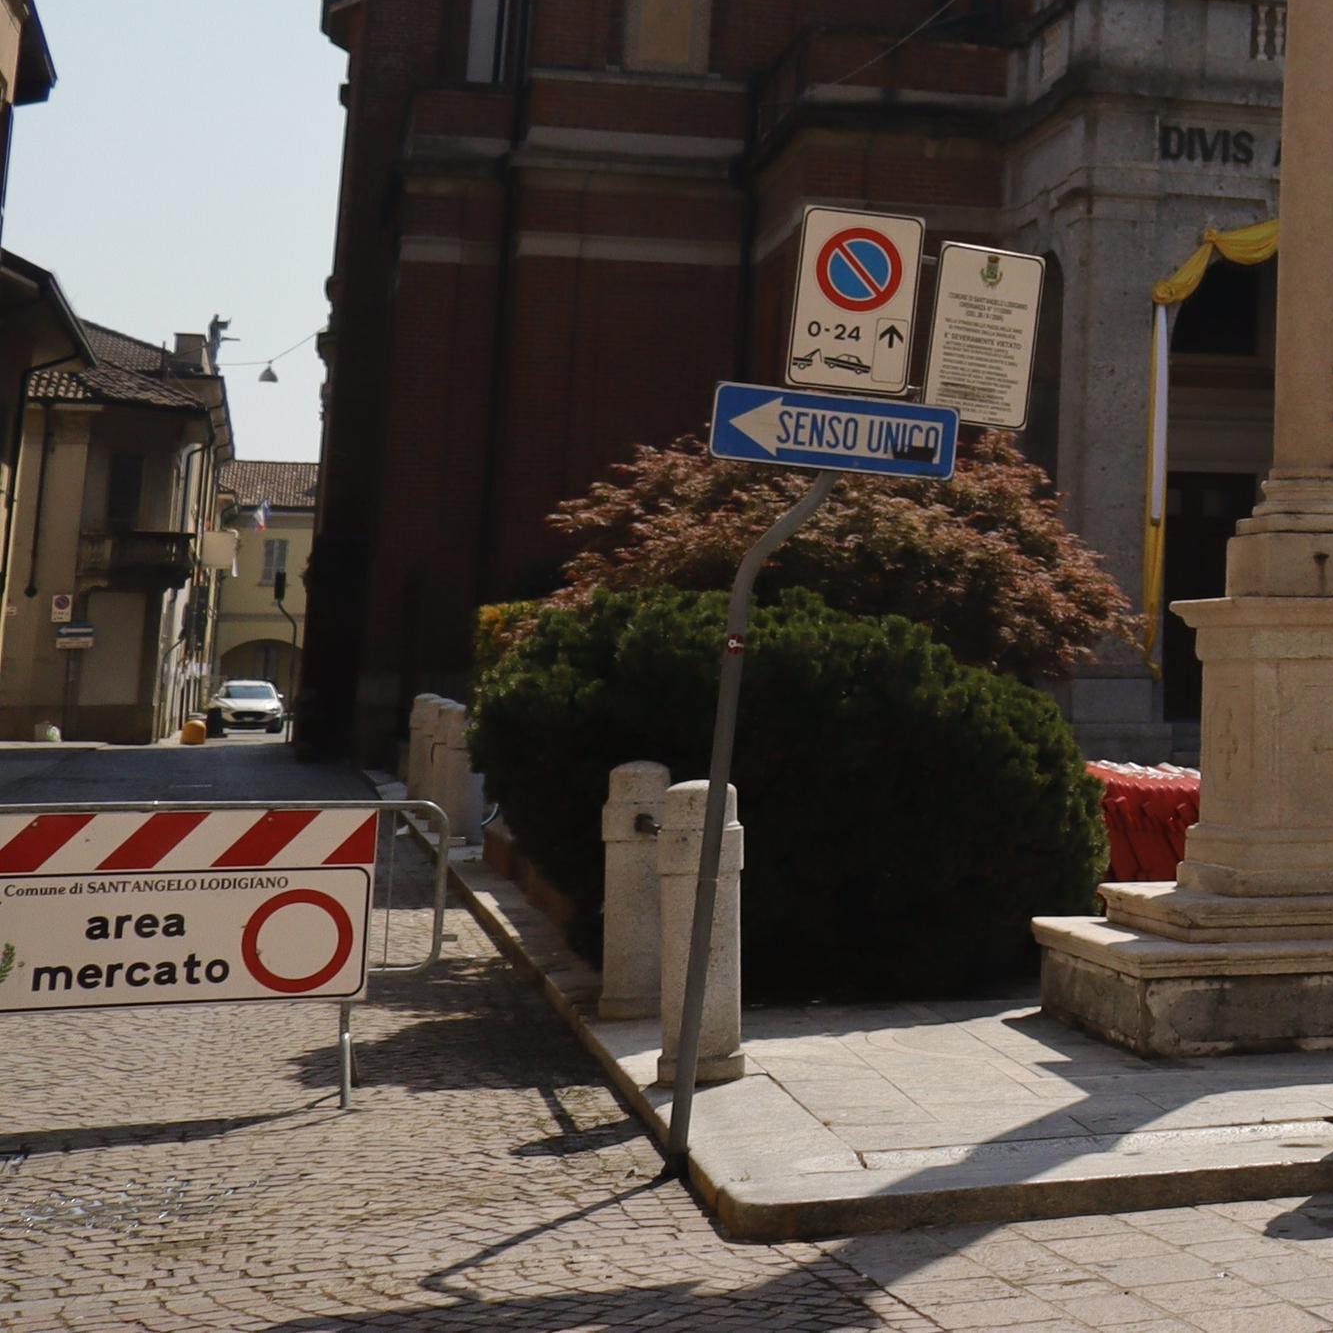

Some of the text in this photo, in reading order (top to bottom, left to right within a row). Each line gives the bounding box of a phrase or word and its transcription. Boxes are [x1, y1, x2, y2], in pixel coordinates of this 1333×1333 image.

[1159, 125, 1254, 164] DIVIS
[776, 410, 859, 451] SENSO
[4, 882, 66, 897] Comune
[70, 883, 83, 895] di
[199, 876, 289, 891] LODIGIANO
[85, 912, 186, 940] area
[31, 953, 230, 992] mercato
